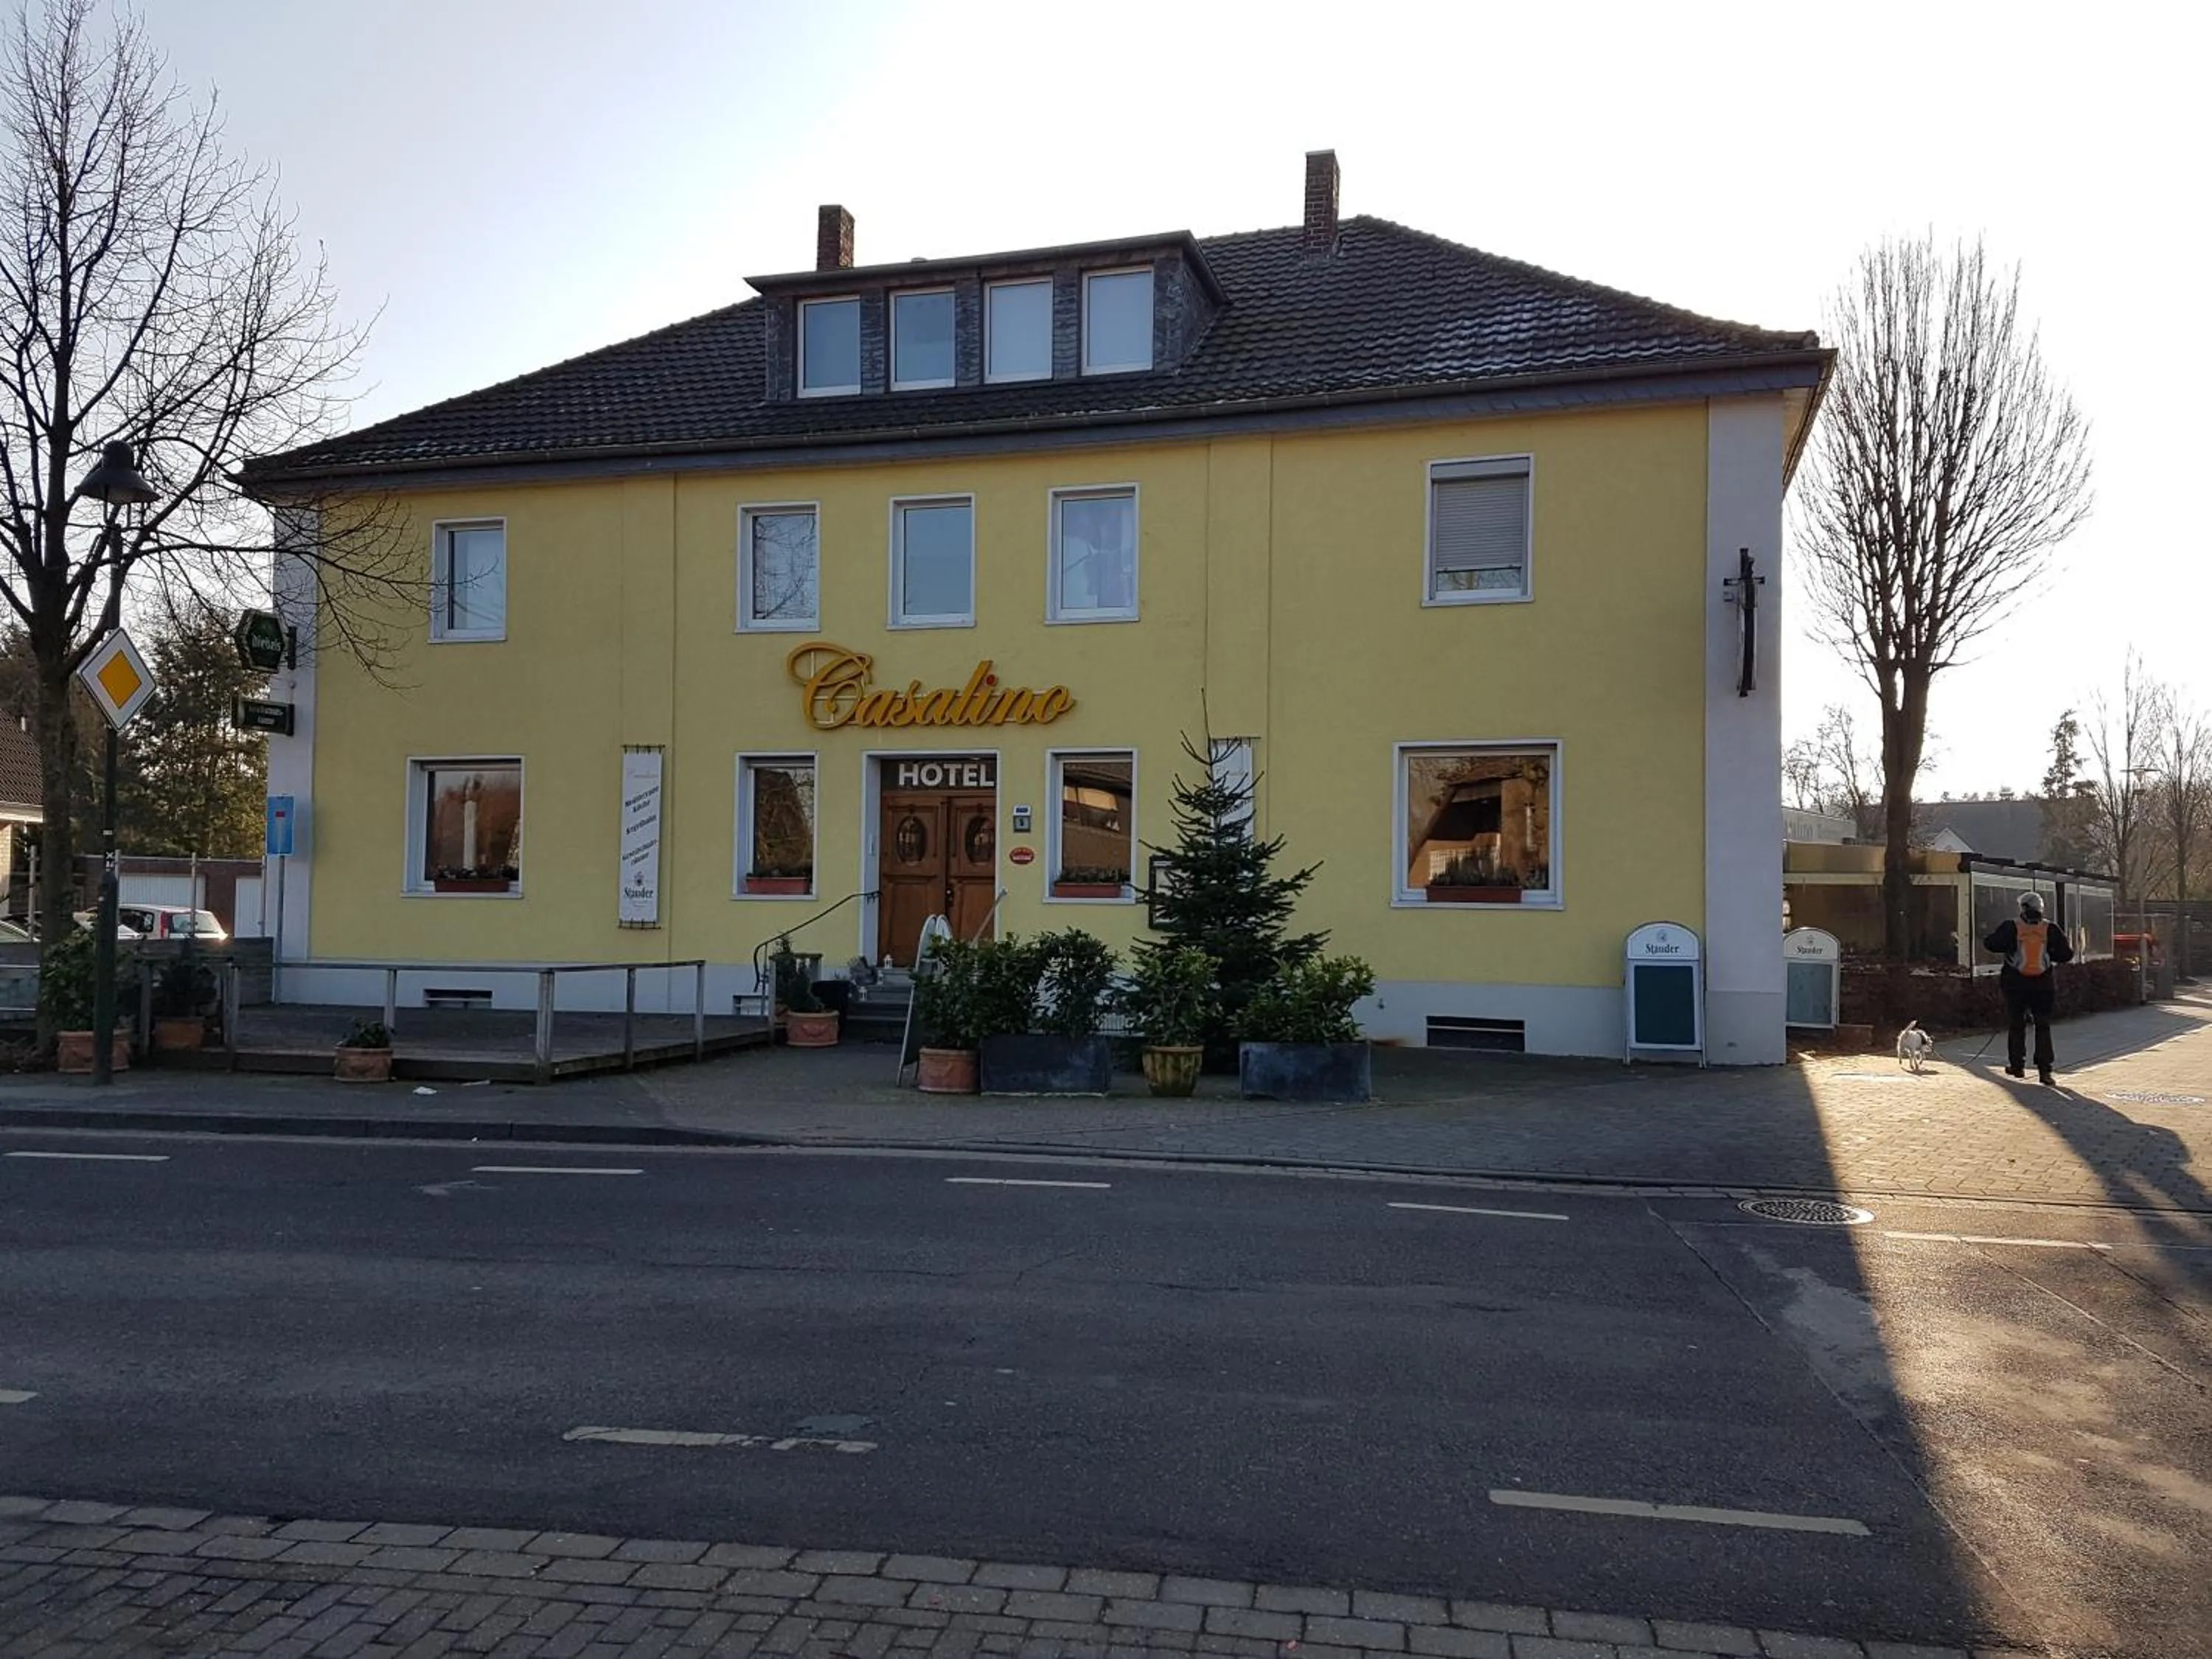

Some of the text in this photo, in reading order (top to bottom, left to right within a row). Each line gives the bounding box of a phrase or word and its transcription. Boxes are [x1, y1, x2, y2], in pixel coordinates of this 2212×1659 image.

[787, 641, 1077, 731] Casalino
[898, 762, 995, 787] HOTEL
[1644, 943, 1680, 955] Stauder
